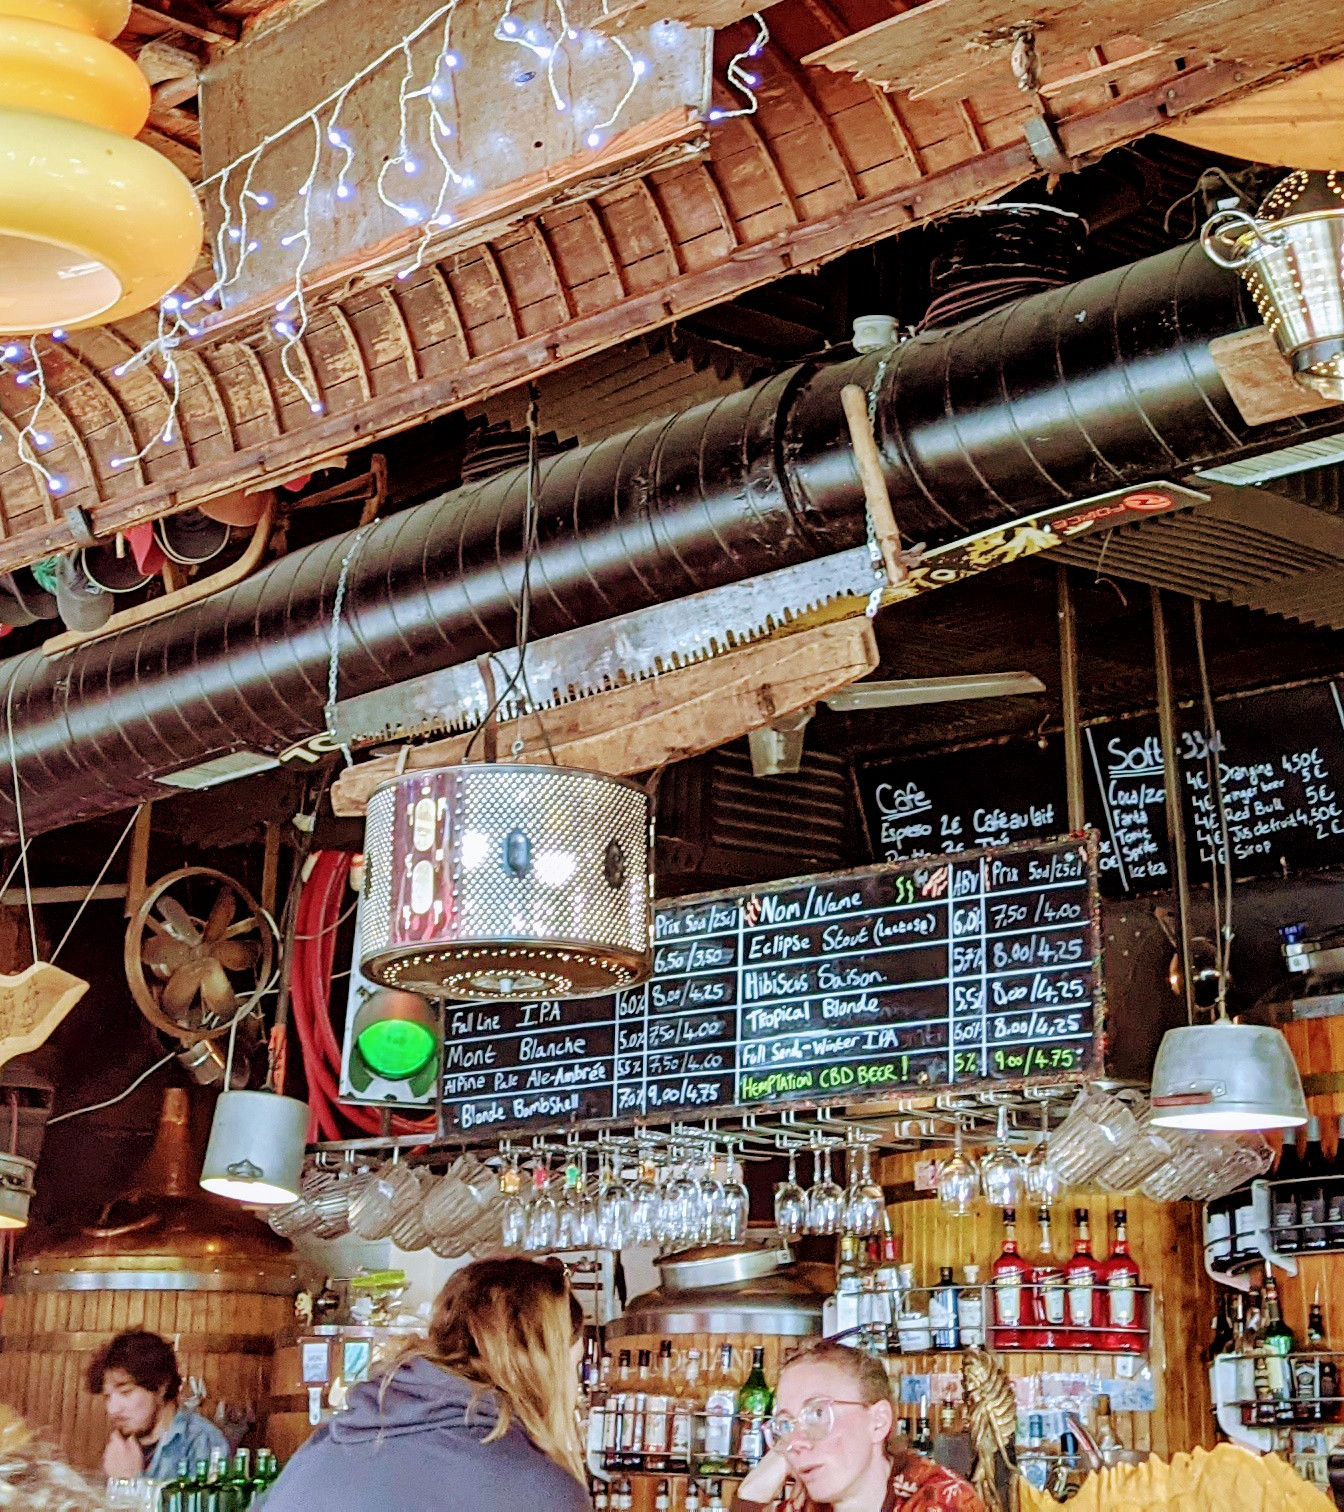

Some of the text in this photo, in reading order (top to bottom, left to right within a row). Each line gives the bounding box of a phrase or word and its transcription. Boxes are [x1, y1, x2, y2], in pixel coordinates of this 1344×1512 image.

[1107, 737, 1165, 770] Soft
[1223, 784, 1336, 823] Red Bull 5€
[1233, 840, 1272, 860] Sirop
[991, 859, 1019, 887] Prix
[748, 935, 812, 960] Eclipse
[821, 923, 869, 952] Stout
[744, 968, 809, 1000] Hibiscus
[744, 1001, 811, 1033] Tropical
[821, 993, 881, 1020] Blonde
[445, 1044, 497, 1069] Mont
[518, 1036, 587, 1063] Blanche
[818, 1068, 855, 1089] CBD
